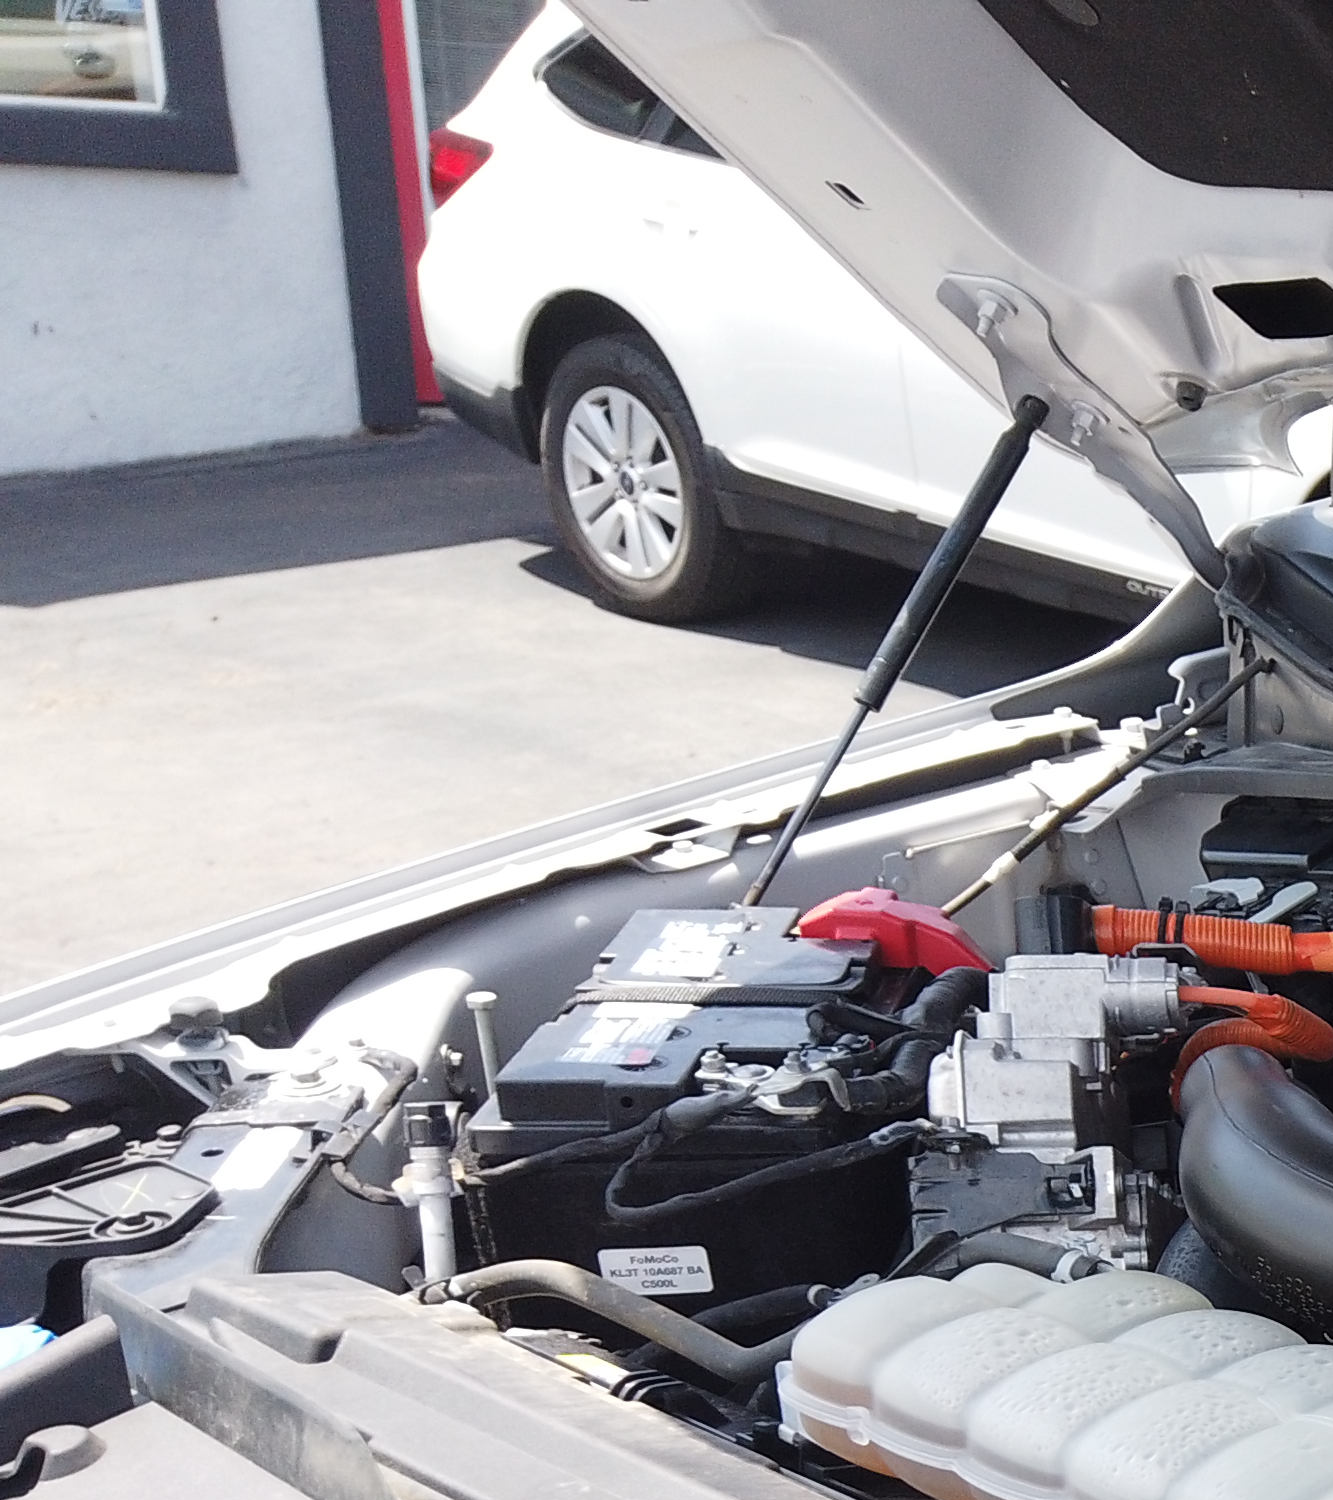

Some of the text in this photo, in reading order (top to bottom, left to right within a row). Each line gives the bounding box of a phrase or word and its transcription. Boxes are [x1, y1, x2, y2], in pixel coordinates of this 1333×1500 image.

[629, 1254, 680, 1265] FoMoCo
[610, 1265, 705, 1278] KL3T 10A687 BA
[640, 1279, 678, 1289] C500L
